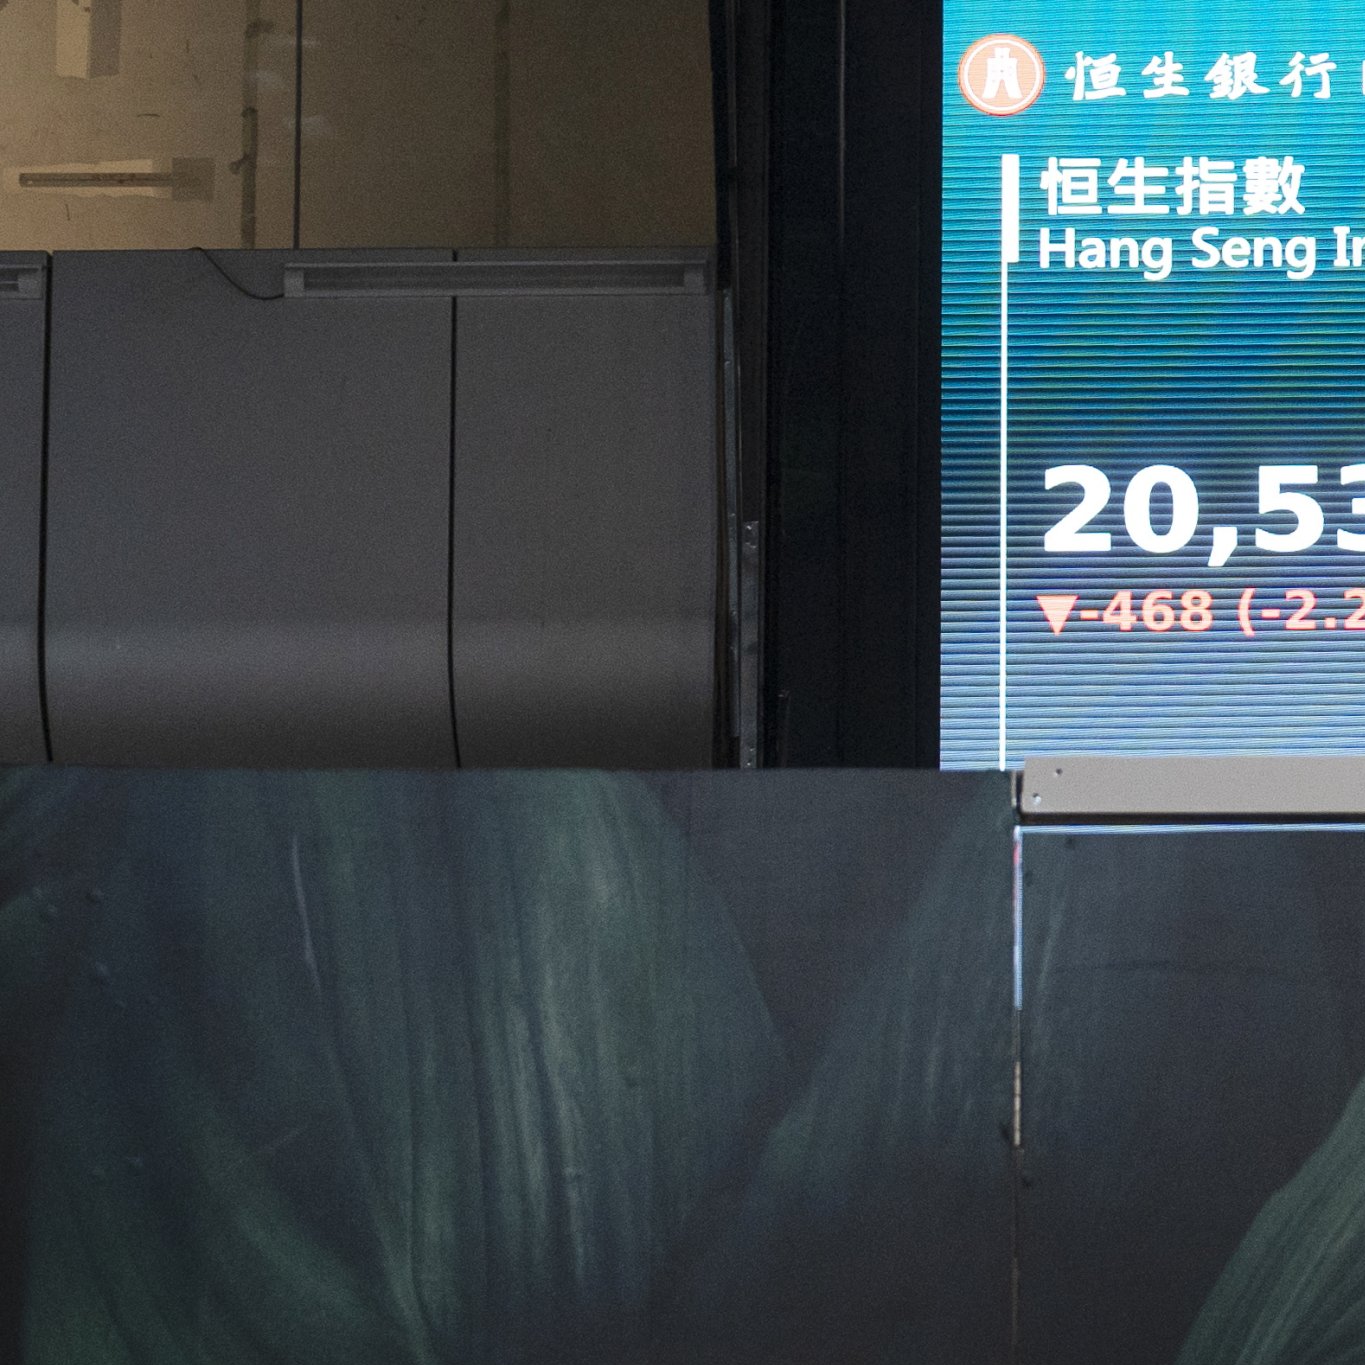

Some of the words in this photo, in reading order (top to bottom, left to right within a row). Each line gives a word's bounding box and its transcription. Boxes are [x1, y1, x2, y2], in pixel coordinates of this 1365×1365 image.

[1064, 51, 1337, 100] 恒生銀行
[1039, 156, 1306, 216] 恒生指數
[1039, 227, 1173, 281] Hang
[1191, 226, 1317, 280] Seng
[1080, 589, 1214, 632] -468
